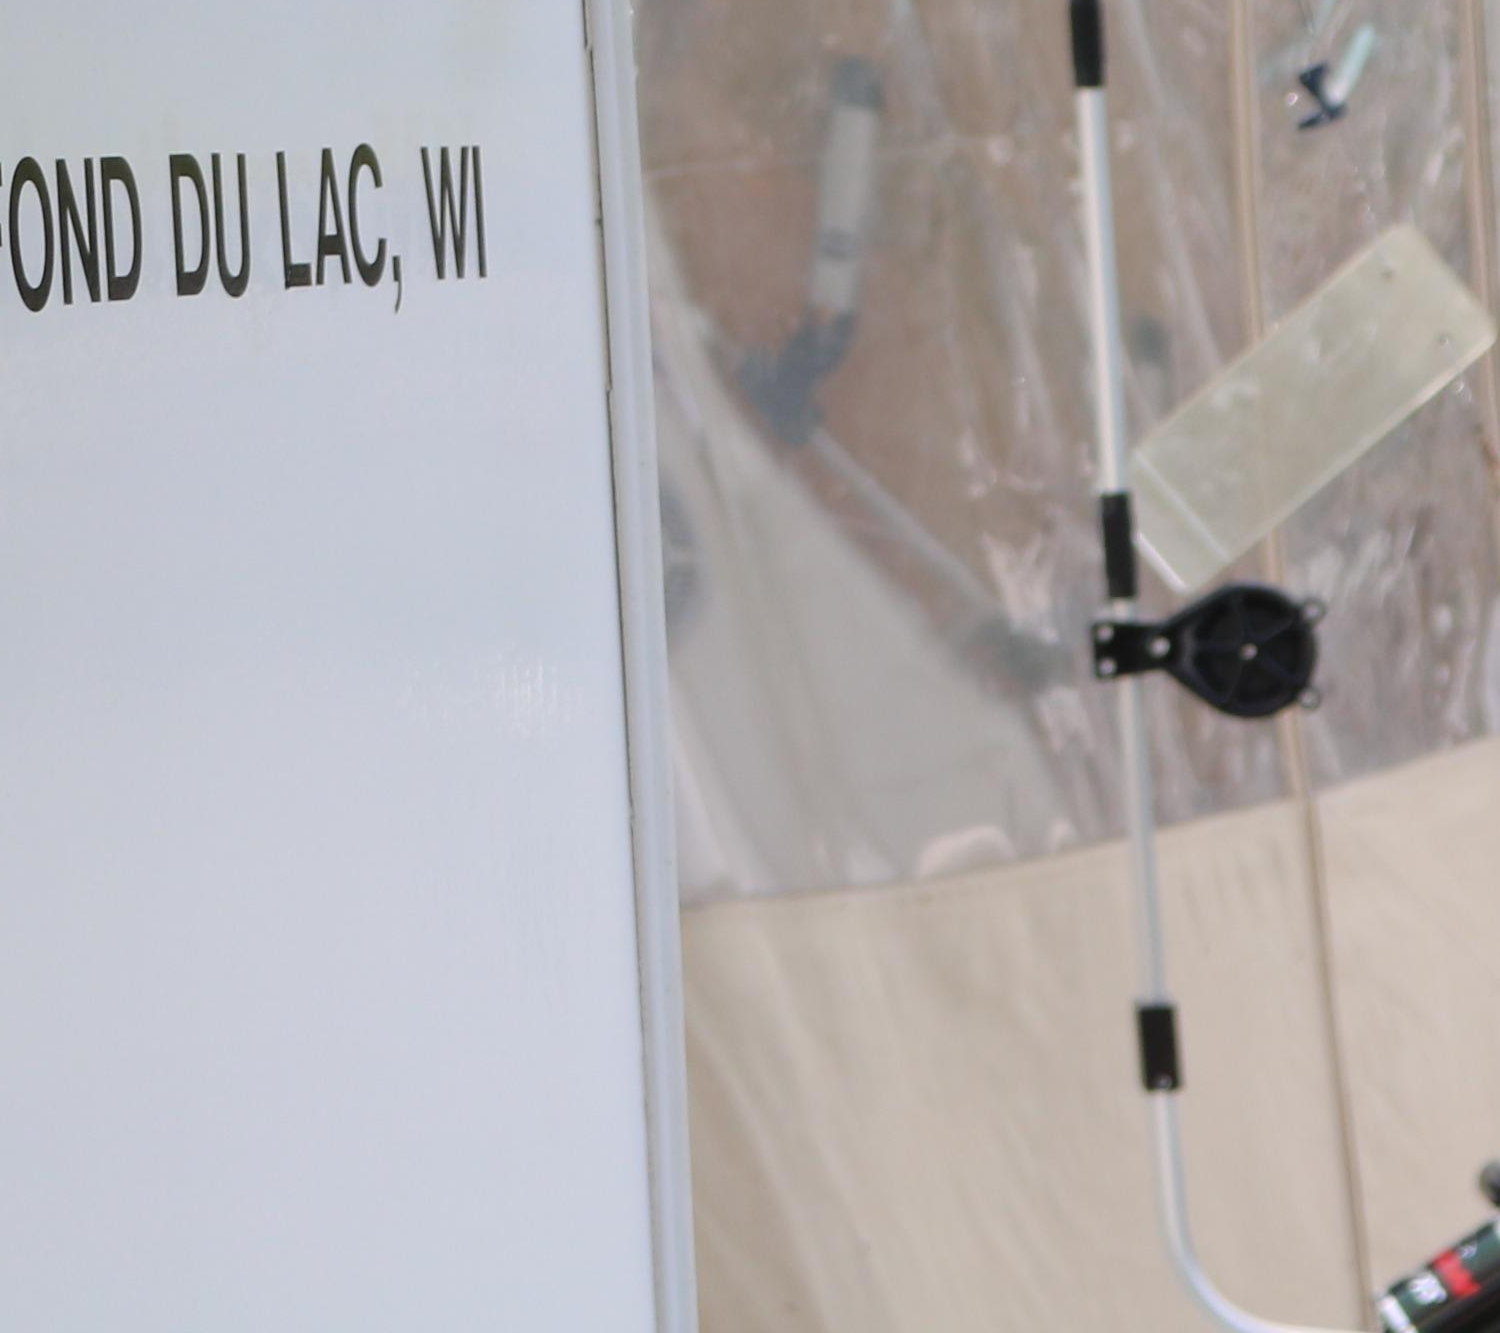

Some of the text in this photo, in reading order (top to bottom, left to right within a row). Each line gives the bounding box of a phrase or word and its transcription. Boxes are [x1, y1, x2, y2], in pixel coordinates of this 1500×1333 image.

[168, 152, 252, 299] DU
[275, 143, 402, 312] LAC,
[420, 145, 488, 280] WI
